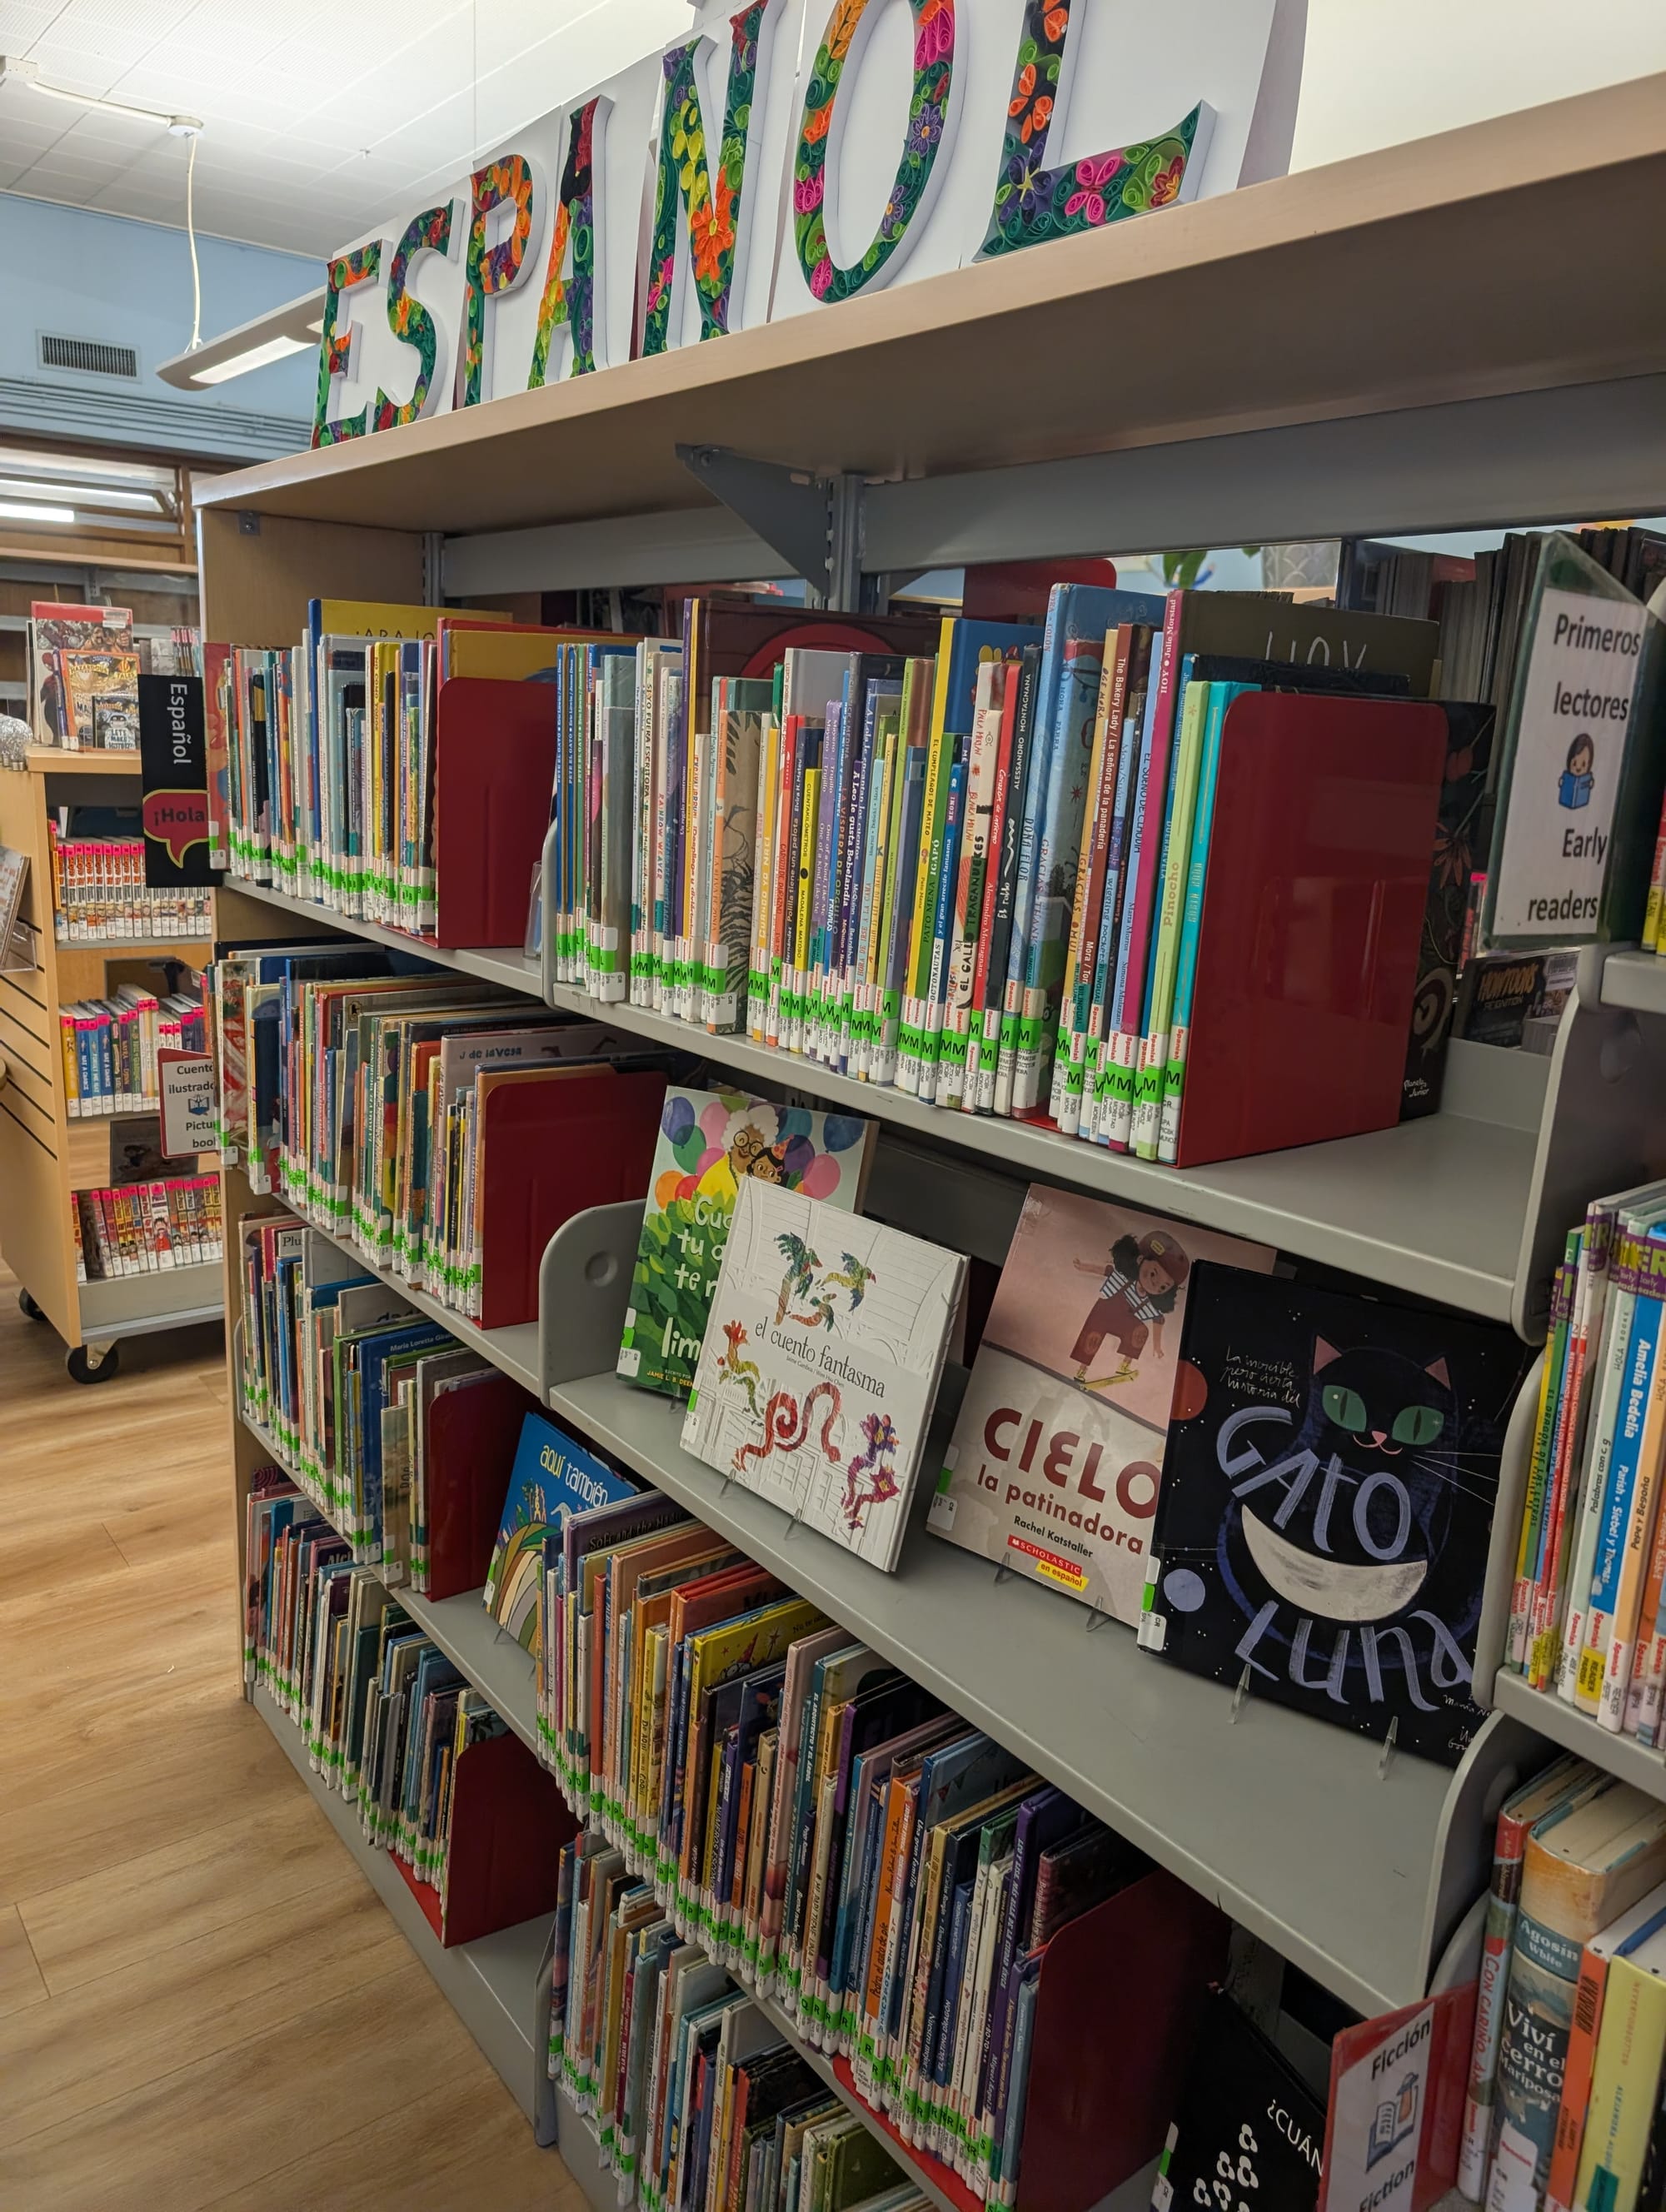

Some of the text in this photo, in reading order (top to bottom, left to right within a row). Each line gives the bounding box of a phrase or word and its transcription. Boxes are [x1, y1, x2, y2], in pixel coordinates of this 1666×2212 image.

[1160, 599, 1176, 694] HOY Julie Morstad
[1554, 613, 1641, 656] Primeros
[1117, 657, 1126, 674] The
[1112, 676, 1125, 708] Bakery
[1554, 682, 1629, 723] lectores
[167, 682, 192, 765] Español
[1014, 737, 1025, 790] ALESSANDRO
[1020, 673, 1031, 733] MONTAGNANA
[1109, 710, 1121, 730] Lady
[932, 739, 940, 748] EL
[1109, 739, 1117, 750] La
[854, 770, 860, 780] A
[928, 750, 939, 796] CUMPLEAÑOS
[1105, 752, 1115, 781] señora
[926, 799, 934, 809] DE
[1102, 797, 1110, 805] la
[1103, 783, 1112, 795] de
[153, 807, 206, 827] ¡Hola
[803, 783, 812, 857] CUENTAKILÓMETROS
[850, 803, 858, 814] le
[925, 810, 933, 836] MATEO
[791, 818, 799, 850] pelota
[847, 815, 858, 847] gusta
[1097, 807, 1109, 850] panadería
[1563, 826, 1609, 864] Early
[943, 838, 952, 872] fantasma
[842, 849, 855, 907] Bebelandia
[940, 874, 950, 902] arrecife
[978, 769, 1007, 977] Corazón de invierno Alessandro Montagnana
[922, 839, 940, 944] PATO MENA IGAPÓ
[1163, 862, 1179, 927] Pinocho
[1528, 889, 1599, 924] readers
[826, 898, 835, 933] PRIMUS
[938, 903, 946, 919] gran
[1085, 940, 1094, 961] Mora
[930, 944, 941, 1000] OCTONAUTAS
[1075, 985, 1083, 1024] BILINGUAL
[1174, 1029, 1185, 1060] Spanish
[1144, 1078, 1156, 1093] M
[1166, 1071, 1180, 1086] M
[1404, 1078, 1427, 1090] Planeta
[1409, 1088, 1429, 1099] Junior
[676, 1228, 705, 1257] tu
[673, 1263, 701, 1291] te
[661, 1317, 701, 1361] lim
[755, 1316, 885, 1398] el cuento fantasma
[1281, 1390, 1300, 1409] del
[1624, 1338, 1651, 1440] Amelia Bedelia
[540, 1444, 608, 1507] aquí también
[984, 1407, 1160, 1519] CIELO
[1614, 1464, 1630, 1497] Parish
[977, 1464, 1145, 1556] la patinadora
[1610, 1502, 1624, 1536] Siebel
[1630, 1527, 1643, 1551] Pepe
[1638, 1476, 1651, 1515] Begoña
[1013, 1514, 1093, 1557] Rachel Katstaller
[1020, 1542, 1081, 1575] SCHOLASTIC
[1040, 1562, 1083, 1587] en español
[1602, 1547, 1617, 1585] Thomas
[1588, 1660, 1603, 1693] READER
[908, 1818, 924, 1889] Una gran familia
[791, 1908, 801, 1932] noches
[1518, 1918, 1579, 1962] Agosín
[1528, 1941, 1564, 1970] White
[1486, 1954, 1500, 1981] CON
[923, 2014, 936, 2043] Nuestra
[1504, 2002, 1555, 2055] Viví
[1371, 2018, 1431, 2081] Ficción
[1501, 2038, 1565, 2088] cerro
[1523, 2040, 1566, 2072] en el
[1499, 2054, 1563, 2102] Mariposa
[1359, 2159, 1415, 2212] Fiction
